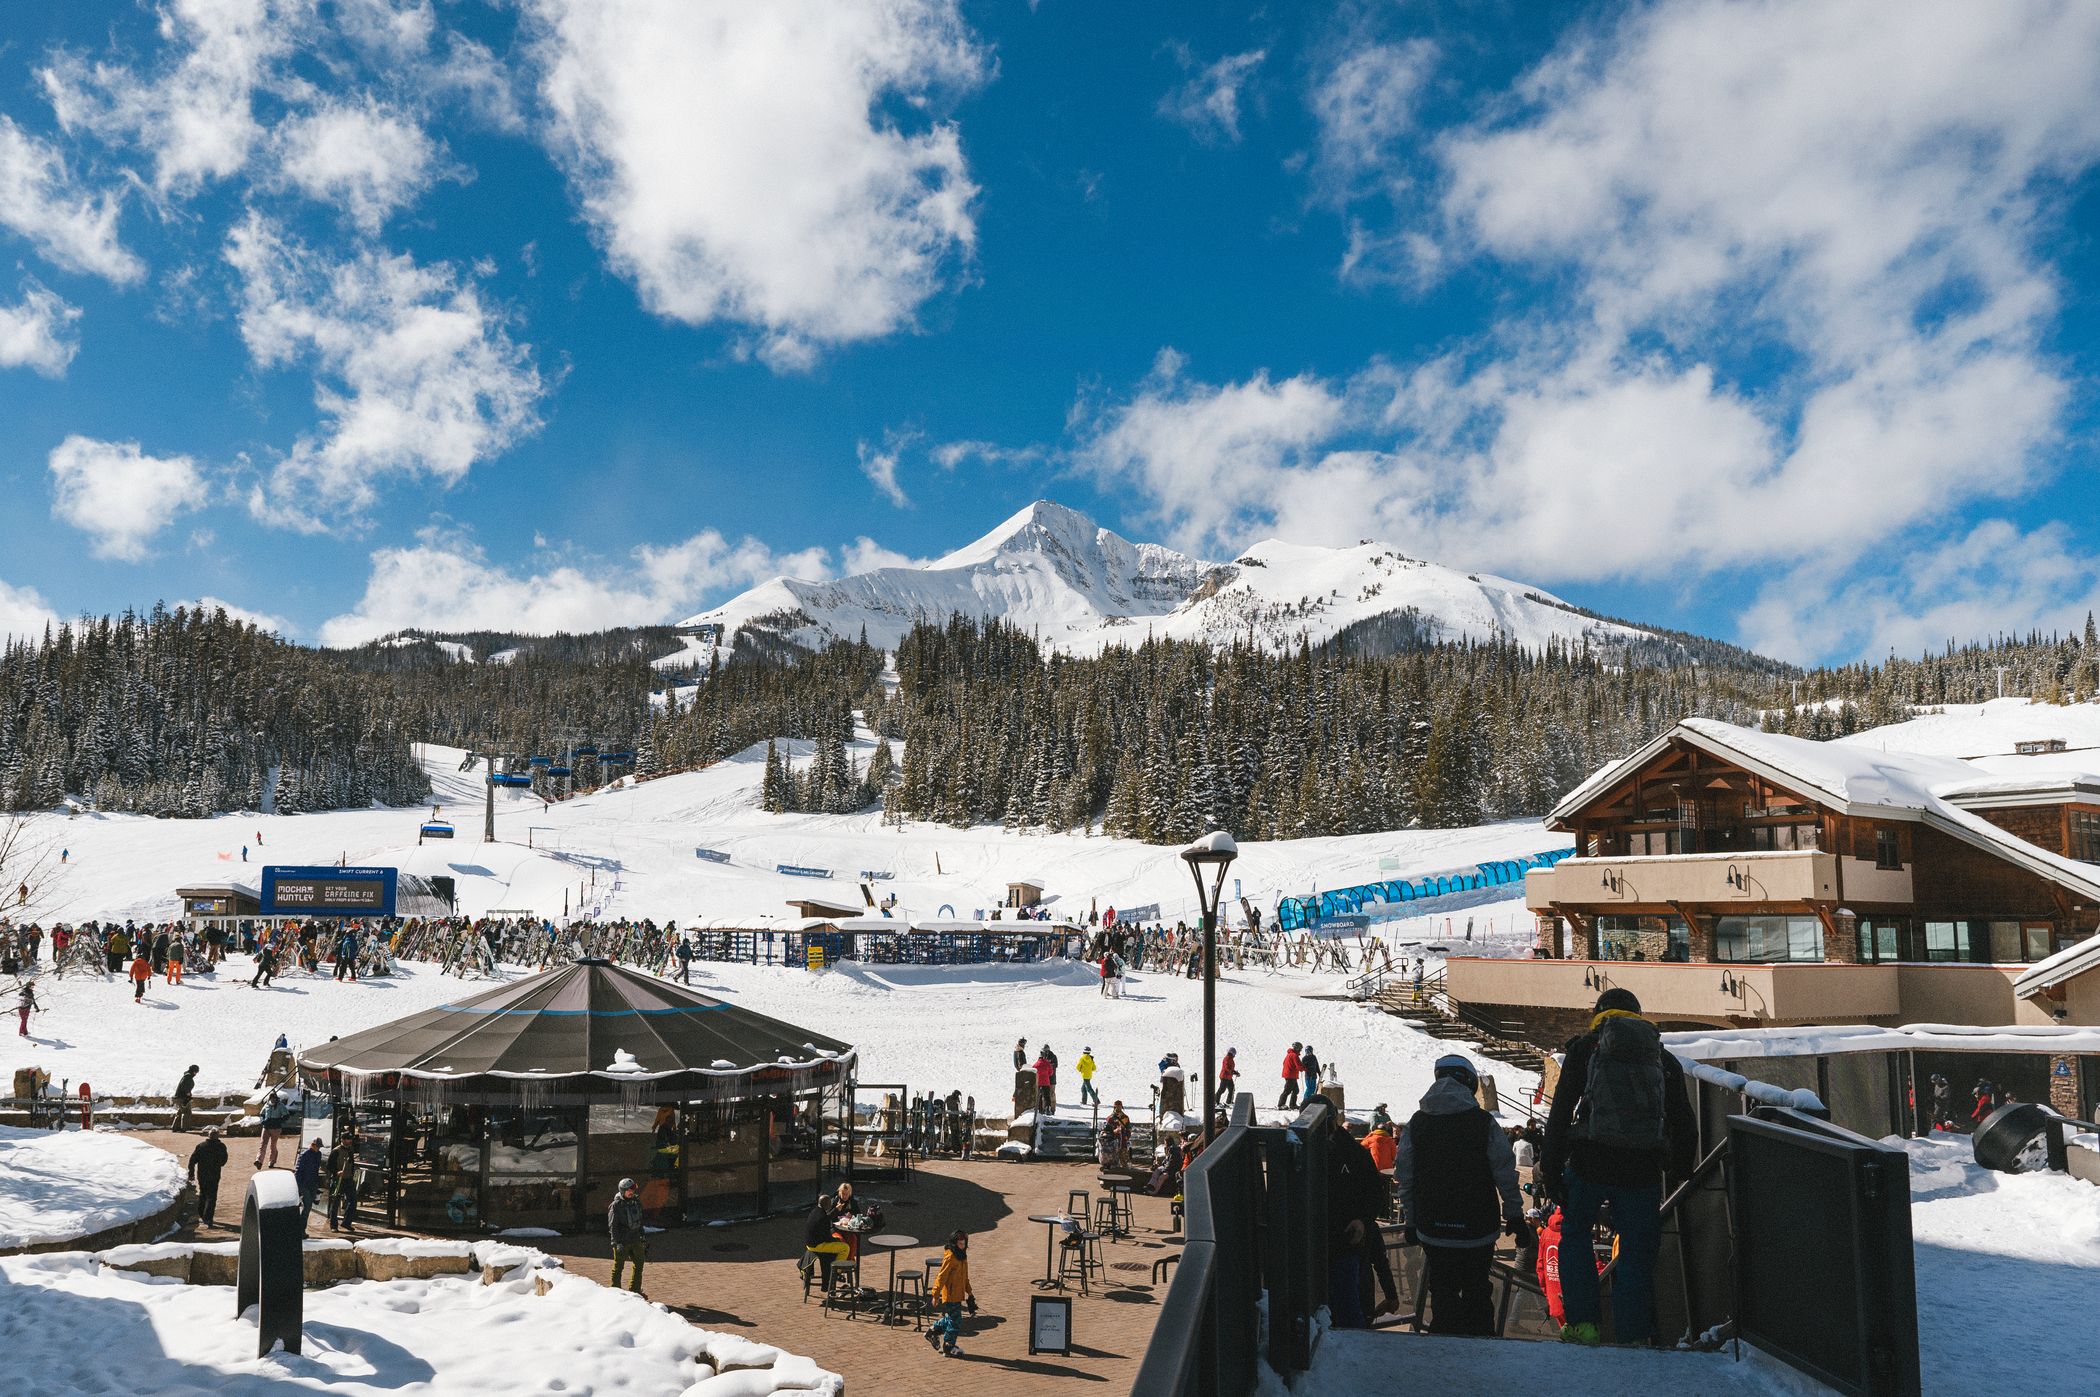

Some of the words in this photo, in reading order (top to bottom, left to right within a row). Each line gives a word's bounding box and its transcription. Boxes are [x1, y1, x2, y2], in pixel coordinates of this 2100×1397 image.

[277, 885, 307, 893] MOCHA
[277, 893, 314, 902] HUNTLEY
[1320, 921, 1355, 929] SNOWBOARD
